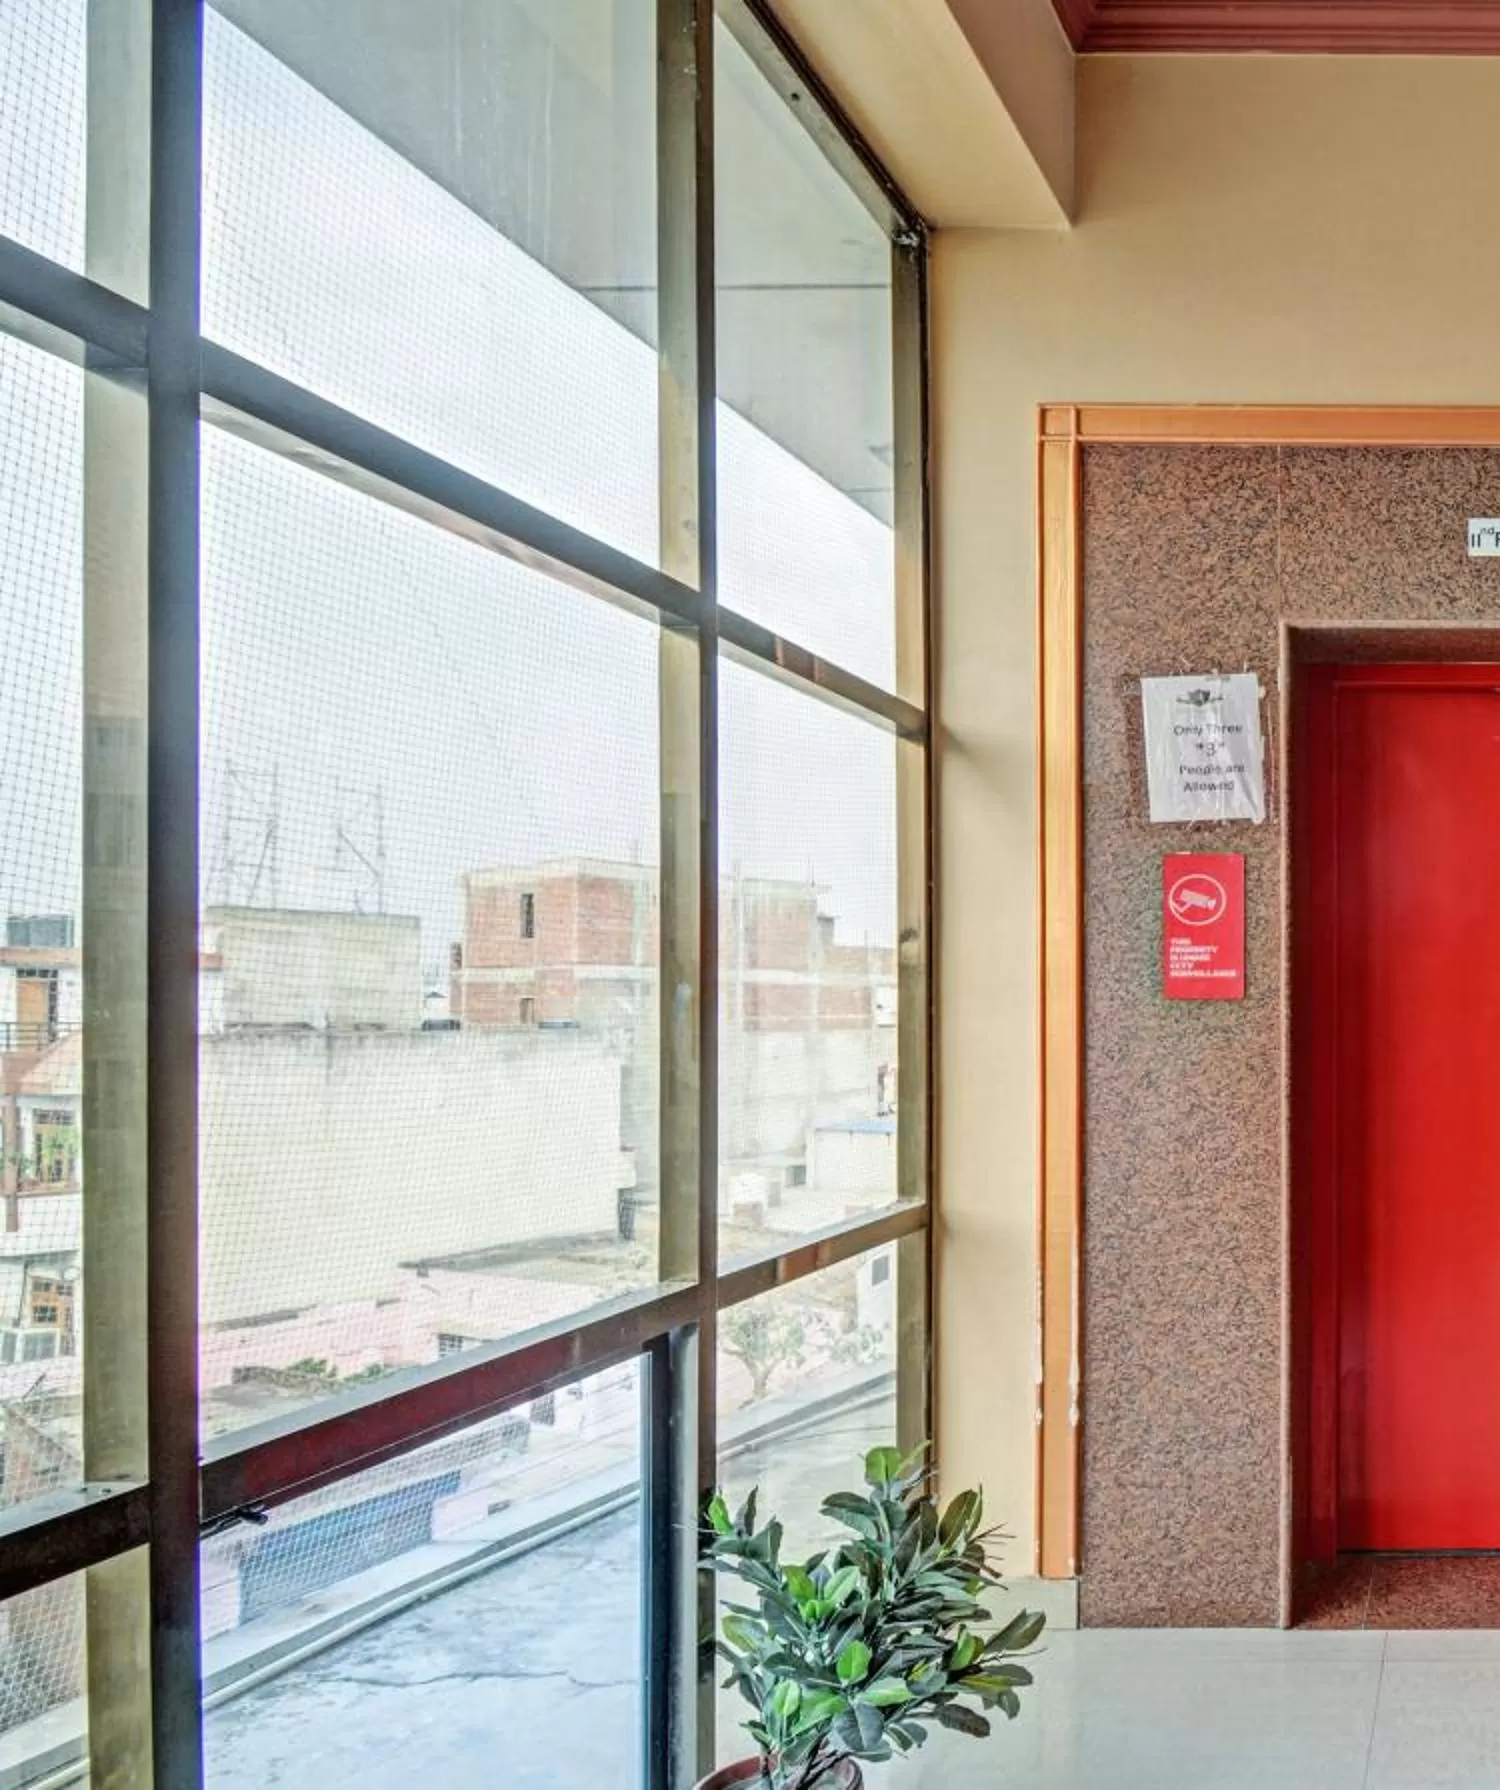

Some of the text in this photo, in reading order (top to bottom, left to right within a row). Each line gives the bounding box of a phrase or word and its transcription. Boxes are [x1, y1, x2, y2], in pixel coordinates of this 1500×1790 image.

[1173, 723, 1243, 737] Only Three
[1179, 763, 1222, 776] People
